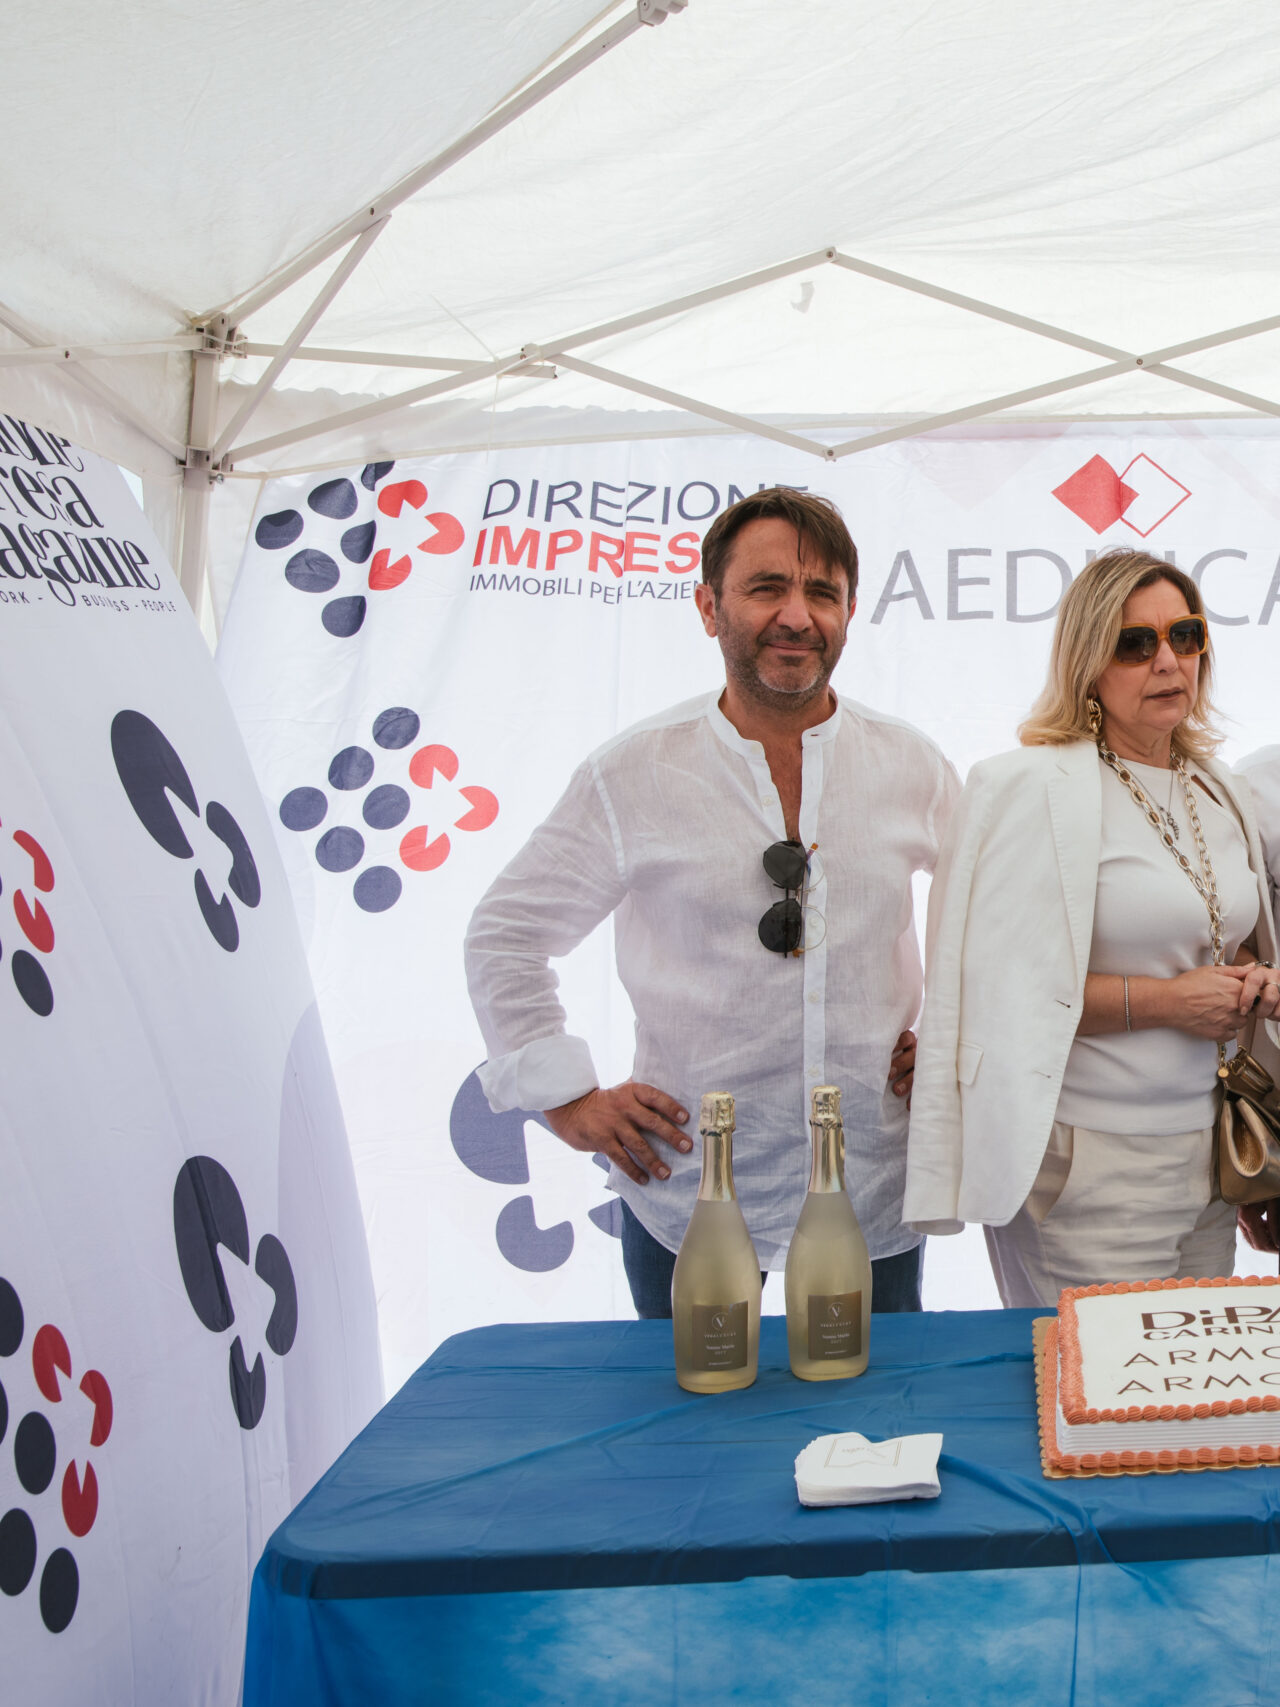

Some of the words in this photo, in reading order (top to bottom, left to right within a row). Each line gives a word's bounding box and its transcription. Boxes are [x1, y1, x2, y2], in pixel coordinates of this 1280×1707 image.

[473, 525, 700, 578] IMPRES
[469, 574, 582, 597] IMMOBILI
[627, 580, 698, 600] L'AZIE
